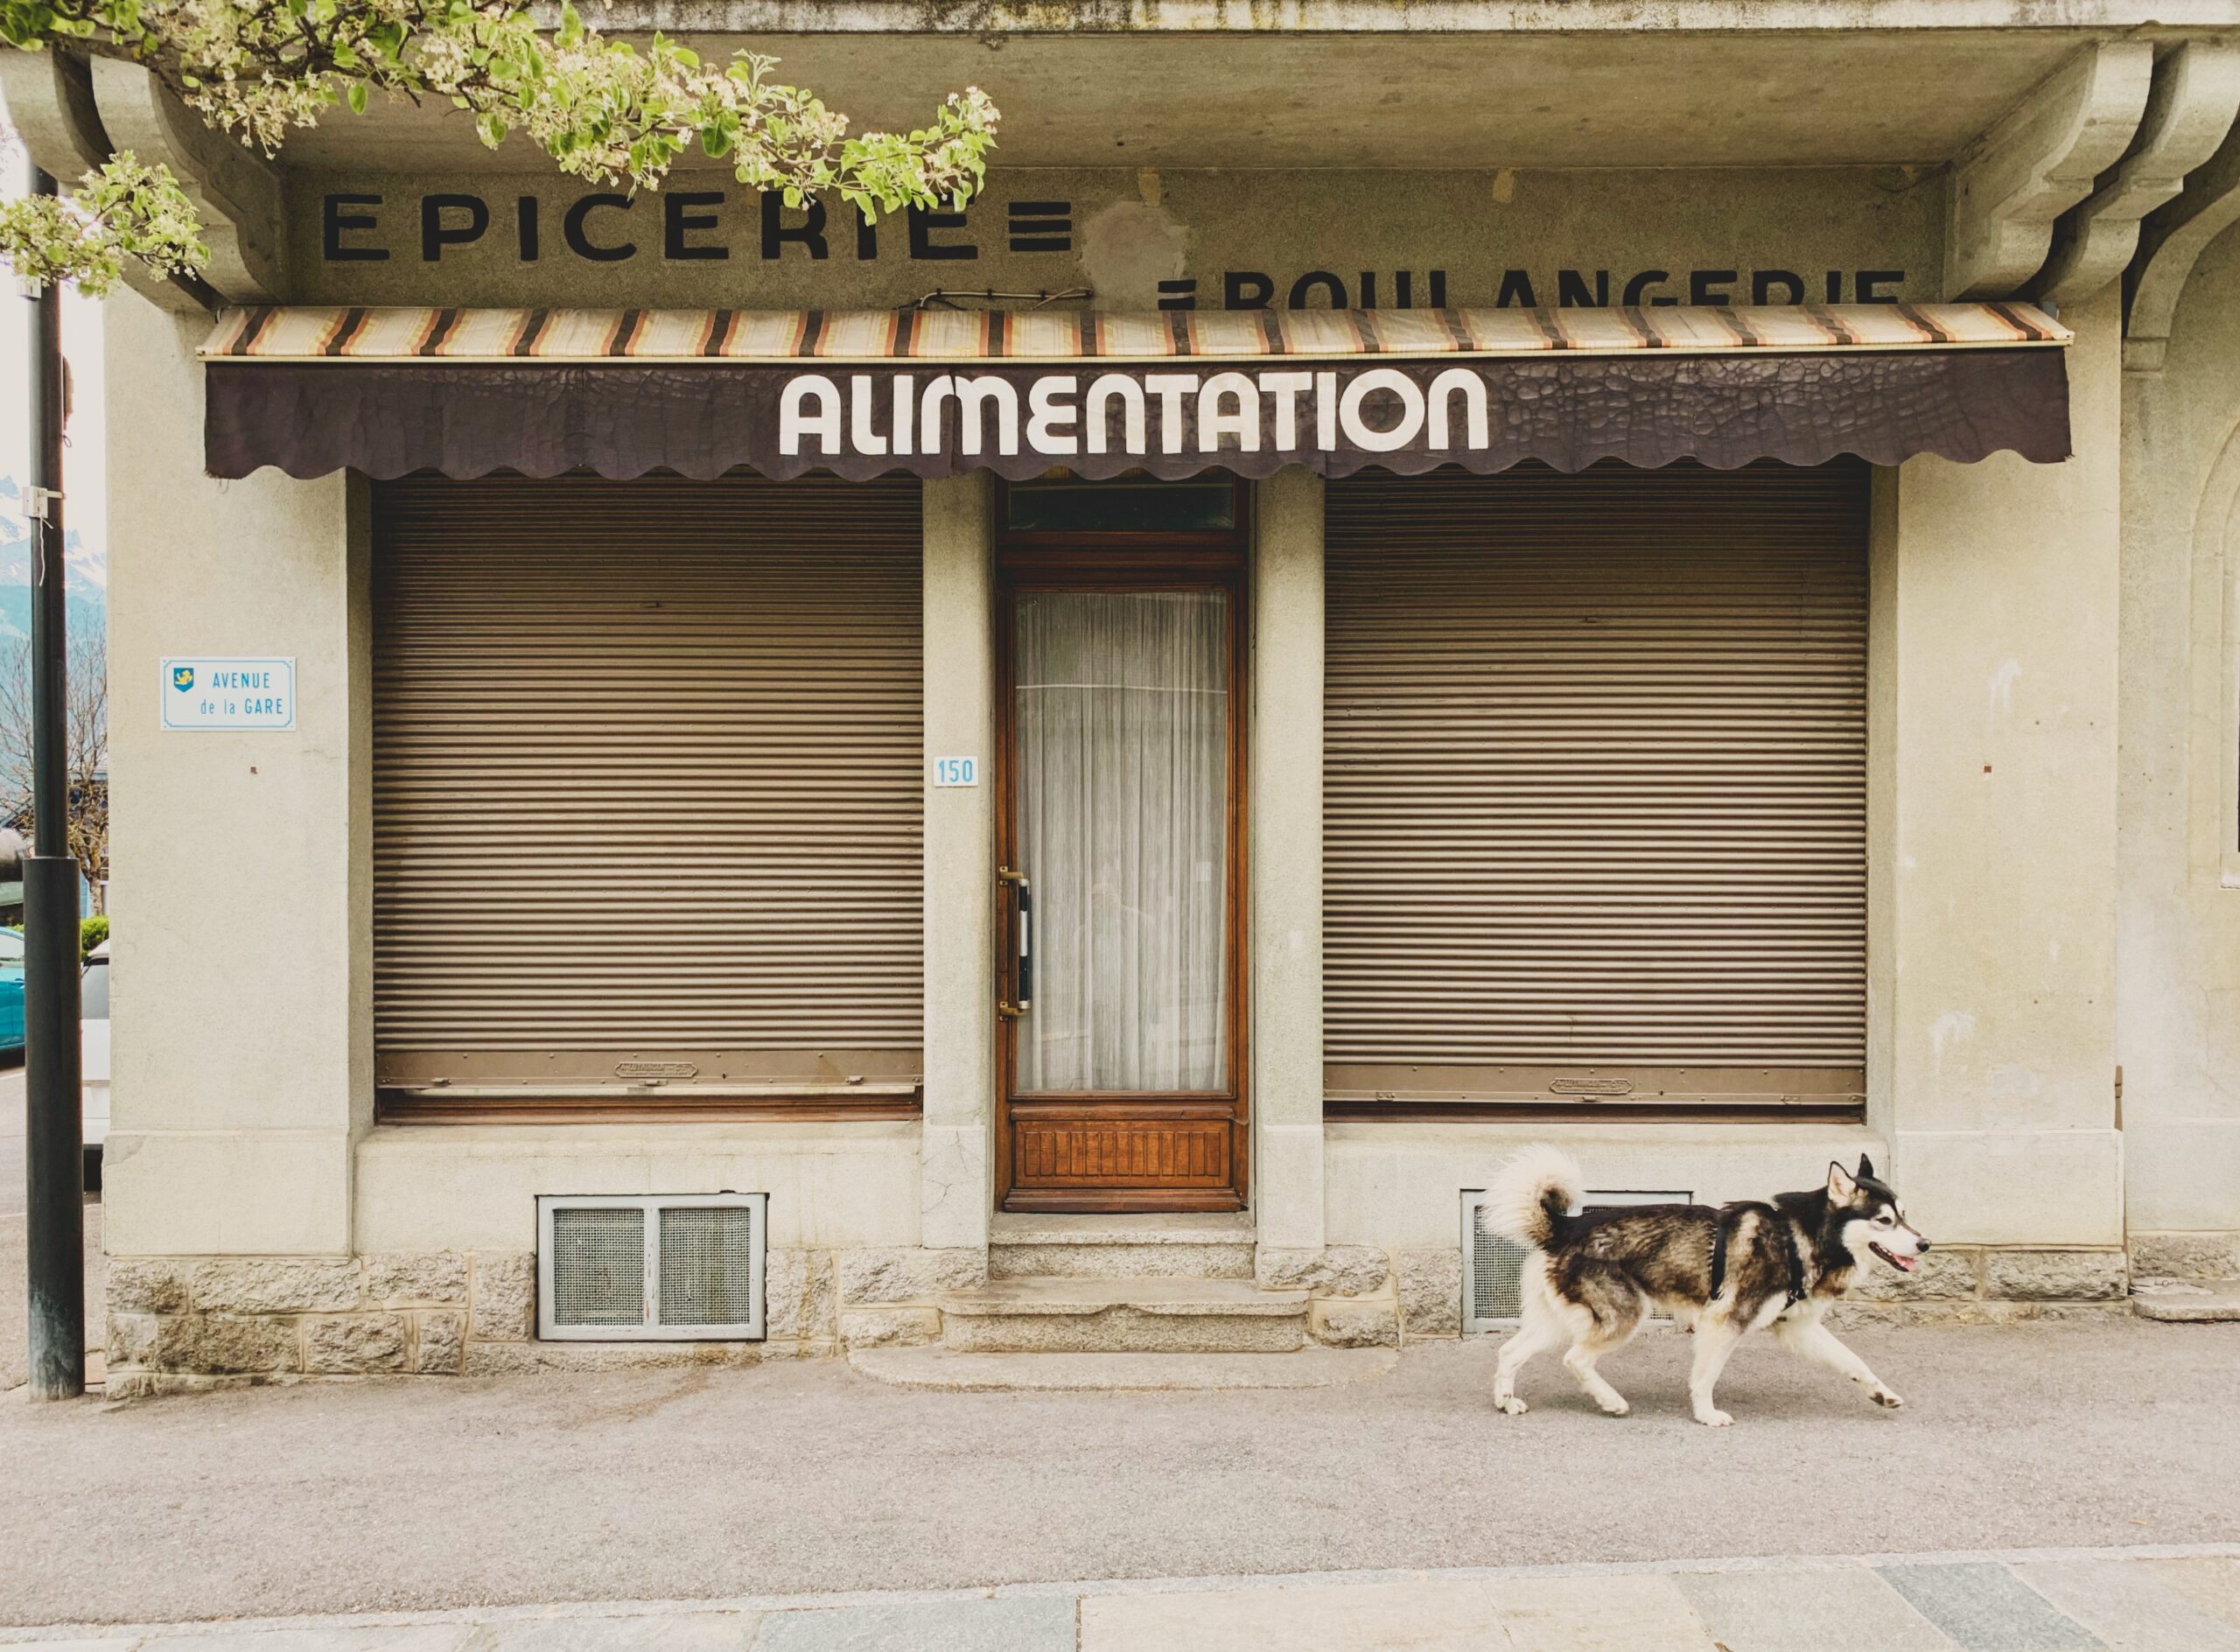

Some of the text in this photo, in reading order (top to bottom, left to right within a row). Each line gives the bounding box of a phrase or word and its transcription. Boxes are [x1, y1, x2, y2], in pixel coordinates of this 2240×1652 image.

[324, 192, 978, 261] EPICERIE
[780, 368, 1489, 455] ALIMENTATION
[213, 672, 270, 689] AVENUE
[200, 698, 283, 715] de la GARE
[938, 760, 973, 783] 150
